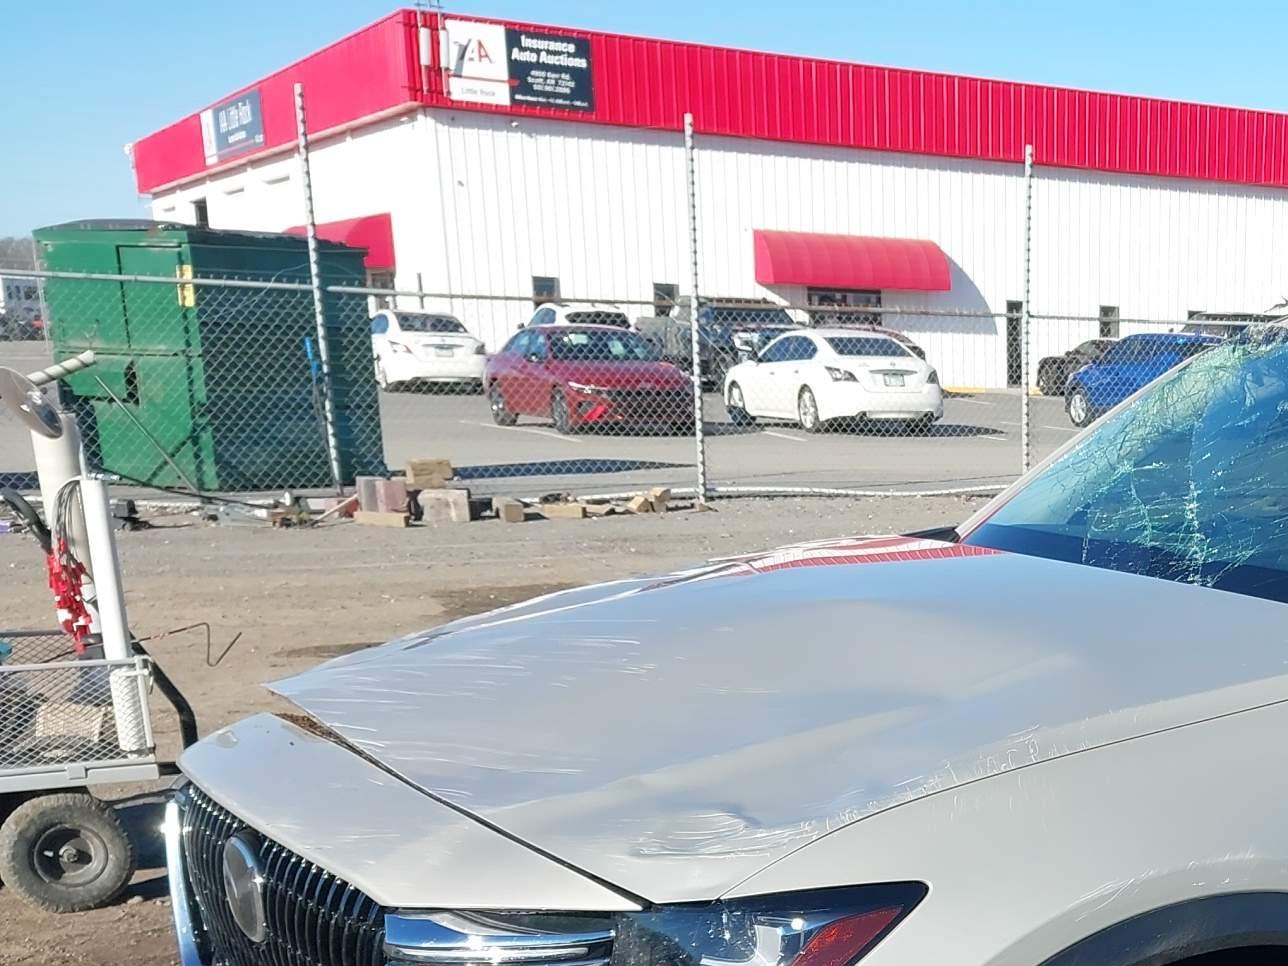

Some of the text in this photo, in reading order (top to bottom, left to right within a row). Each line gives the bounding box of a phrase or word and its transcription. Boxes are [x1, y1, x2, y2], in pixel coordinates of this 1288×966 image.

[520, 35, 576, 53] Insurance
[511, 47, 588, 70] Auto Auctions
